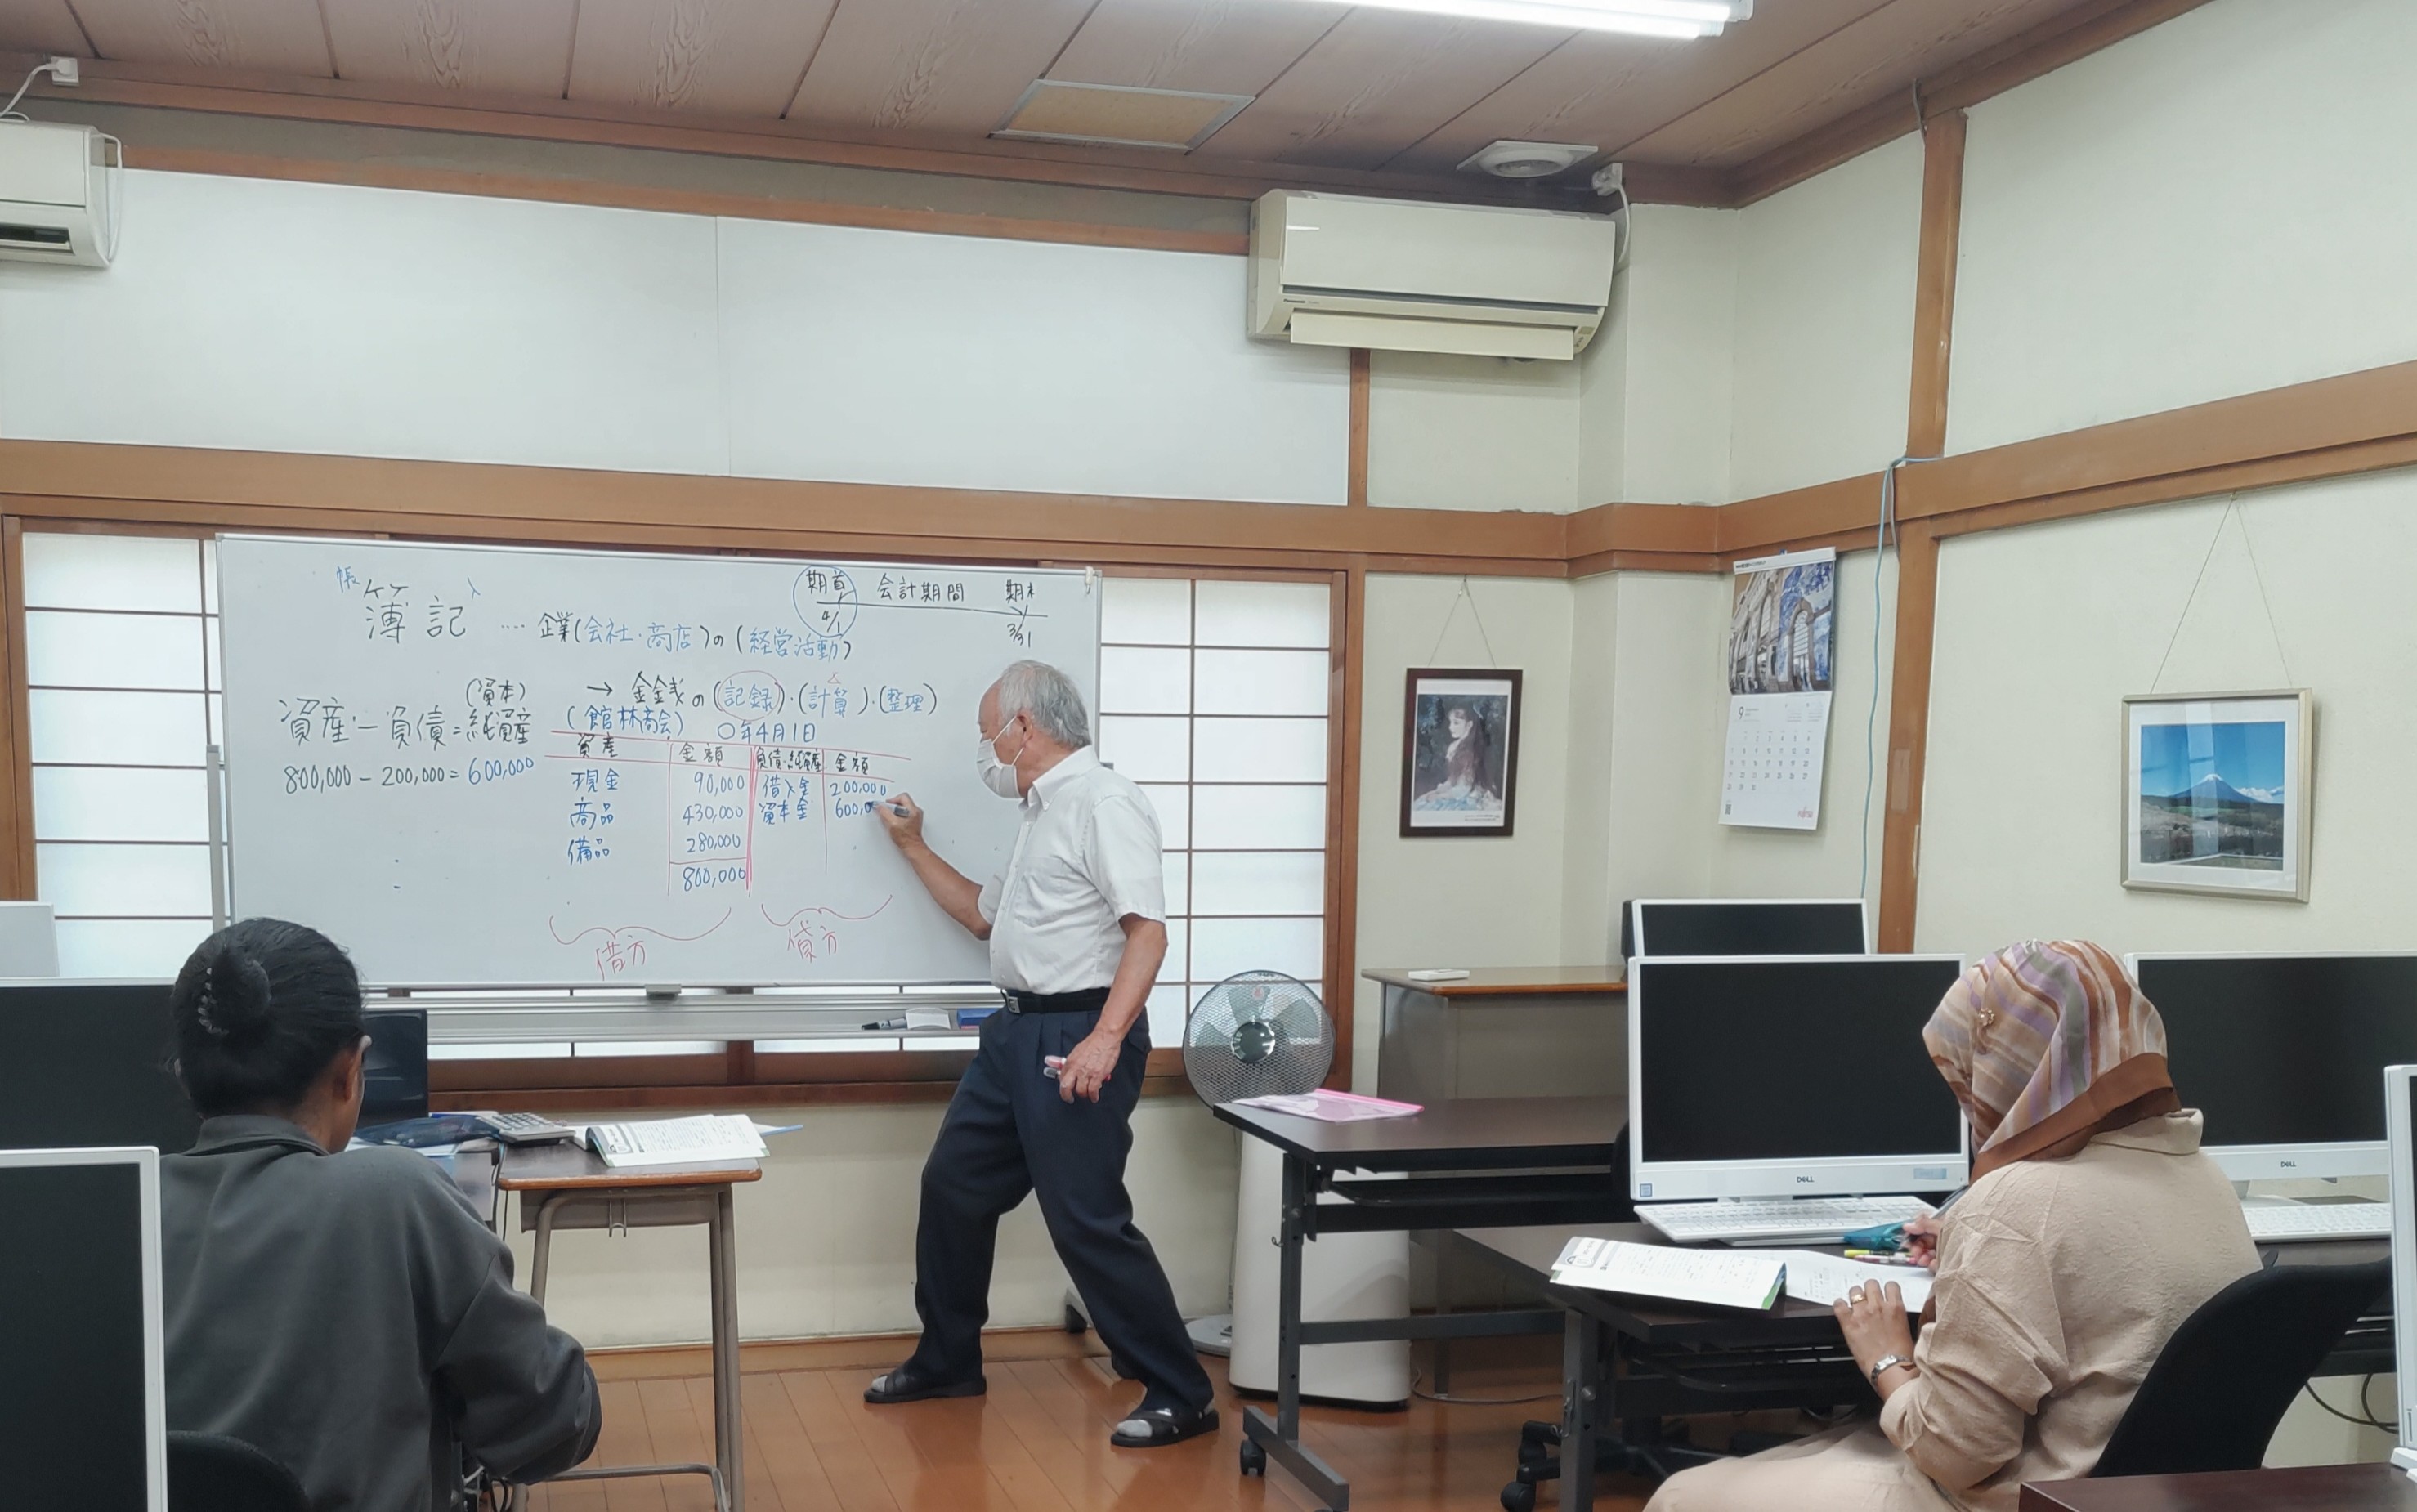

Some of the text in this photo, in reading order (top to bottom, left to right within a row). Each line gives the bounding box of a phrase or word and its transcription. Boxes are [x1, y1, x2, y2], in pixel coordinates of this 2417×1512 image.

[877, 572, 965, 603] 会計期間
[678, 741, 724, 767] 金額
[571, 767, 620, 793] 現金
[694, 771, 745, 798] 90,000
[829, 780, 888, 797] 200,000
[570, 796, 614, 830] 商品
[682, 803, 744, 826] 430,000
[568, 834, 610, 866] 備品
[686, 831, 741, 853] 280,000
[683, 866, 747, 892] 800,000
[1797, 1175, 1815, 1183] DELL
